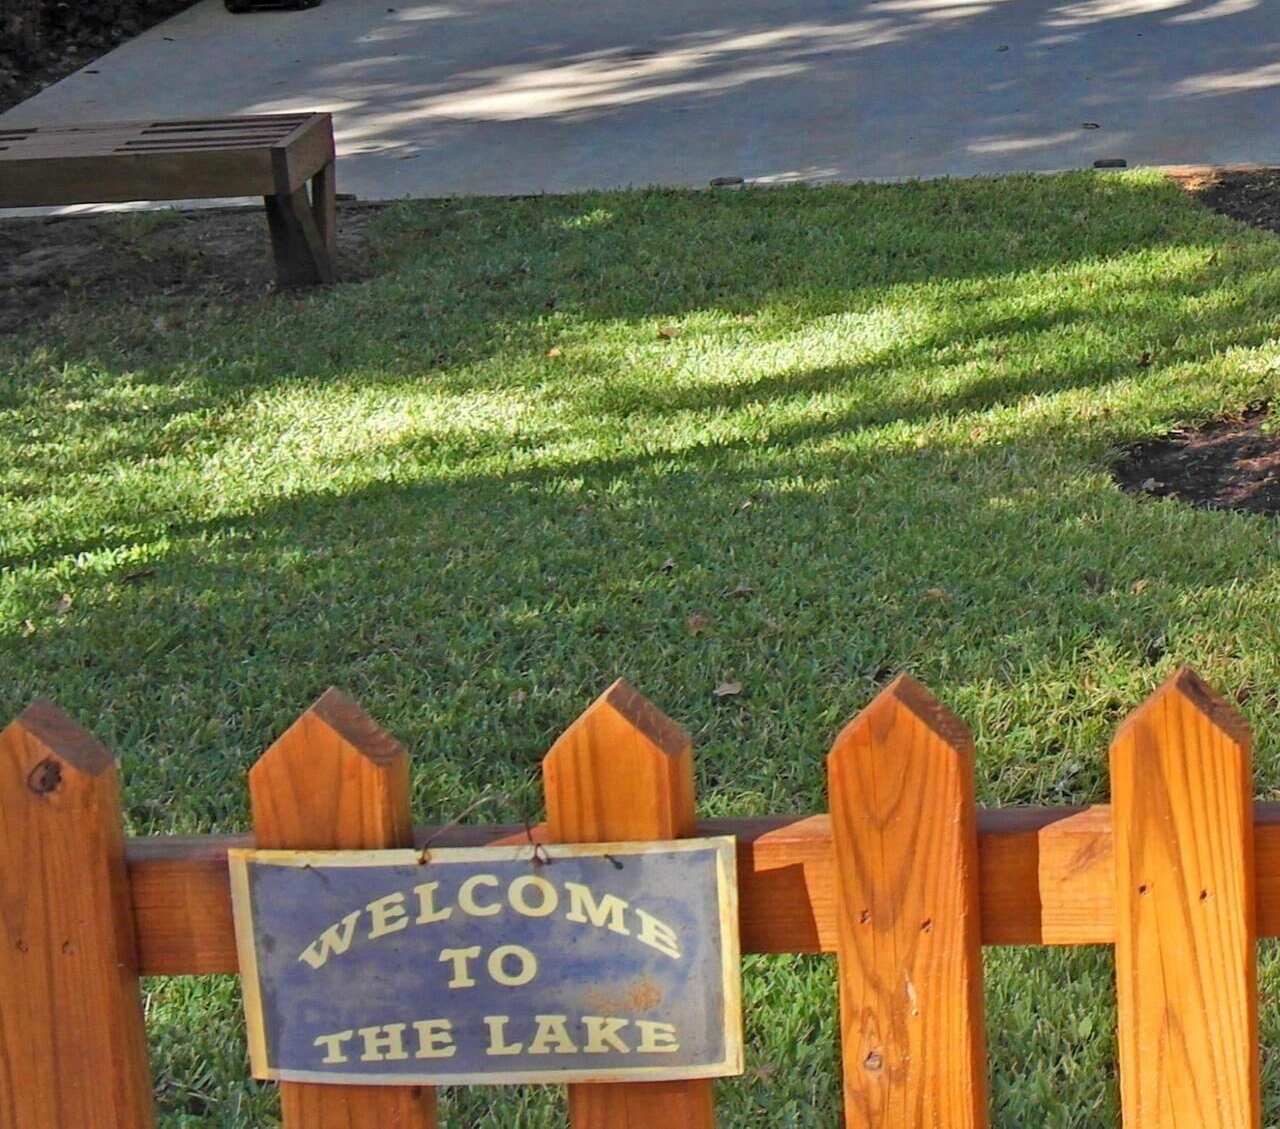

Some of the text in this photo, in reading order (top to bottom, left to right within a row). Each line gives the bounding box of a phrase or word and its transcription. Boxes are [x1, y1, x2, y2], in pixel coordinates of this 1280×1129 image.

[298, 874, 681, 970] WELCOME
[438, 944, 538, 989] TO
[313, 1014, 680, 1064] THE LAKE
